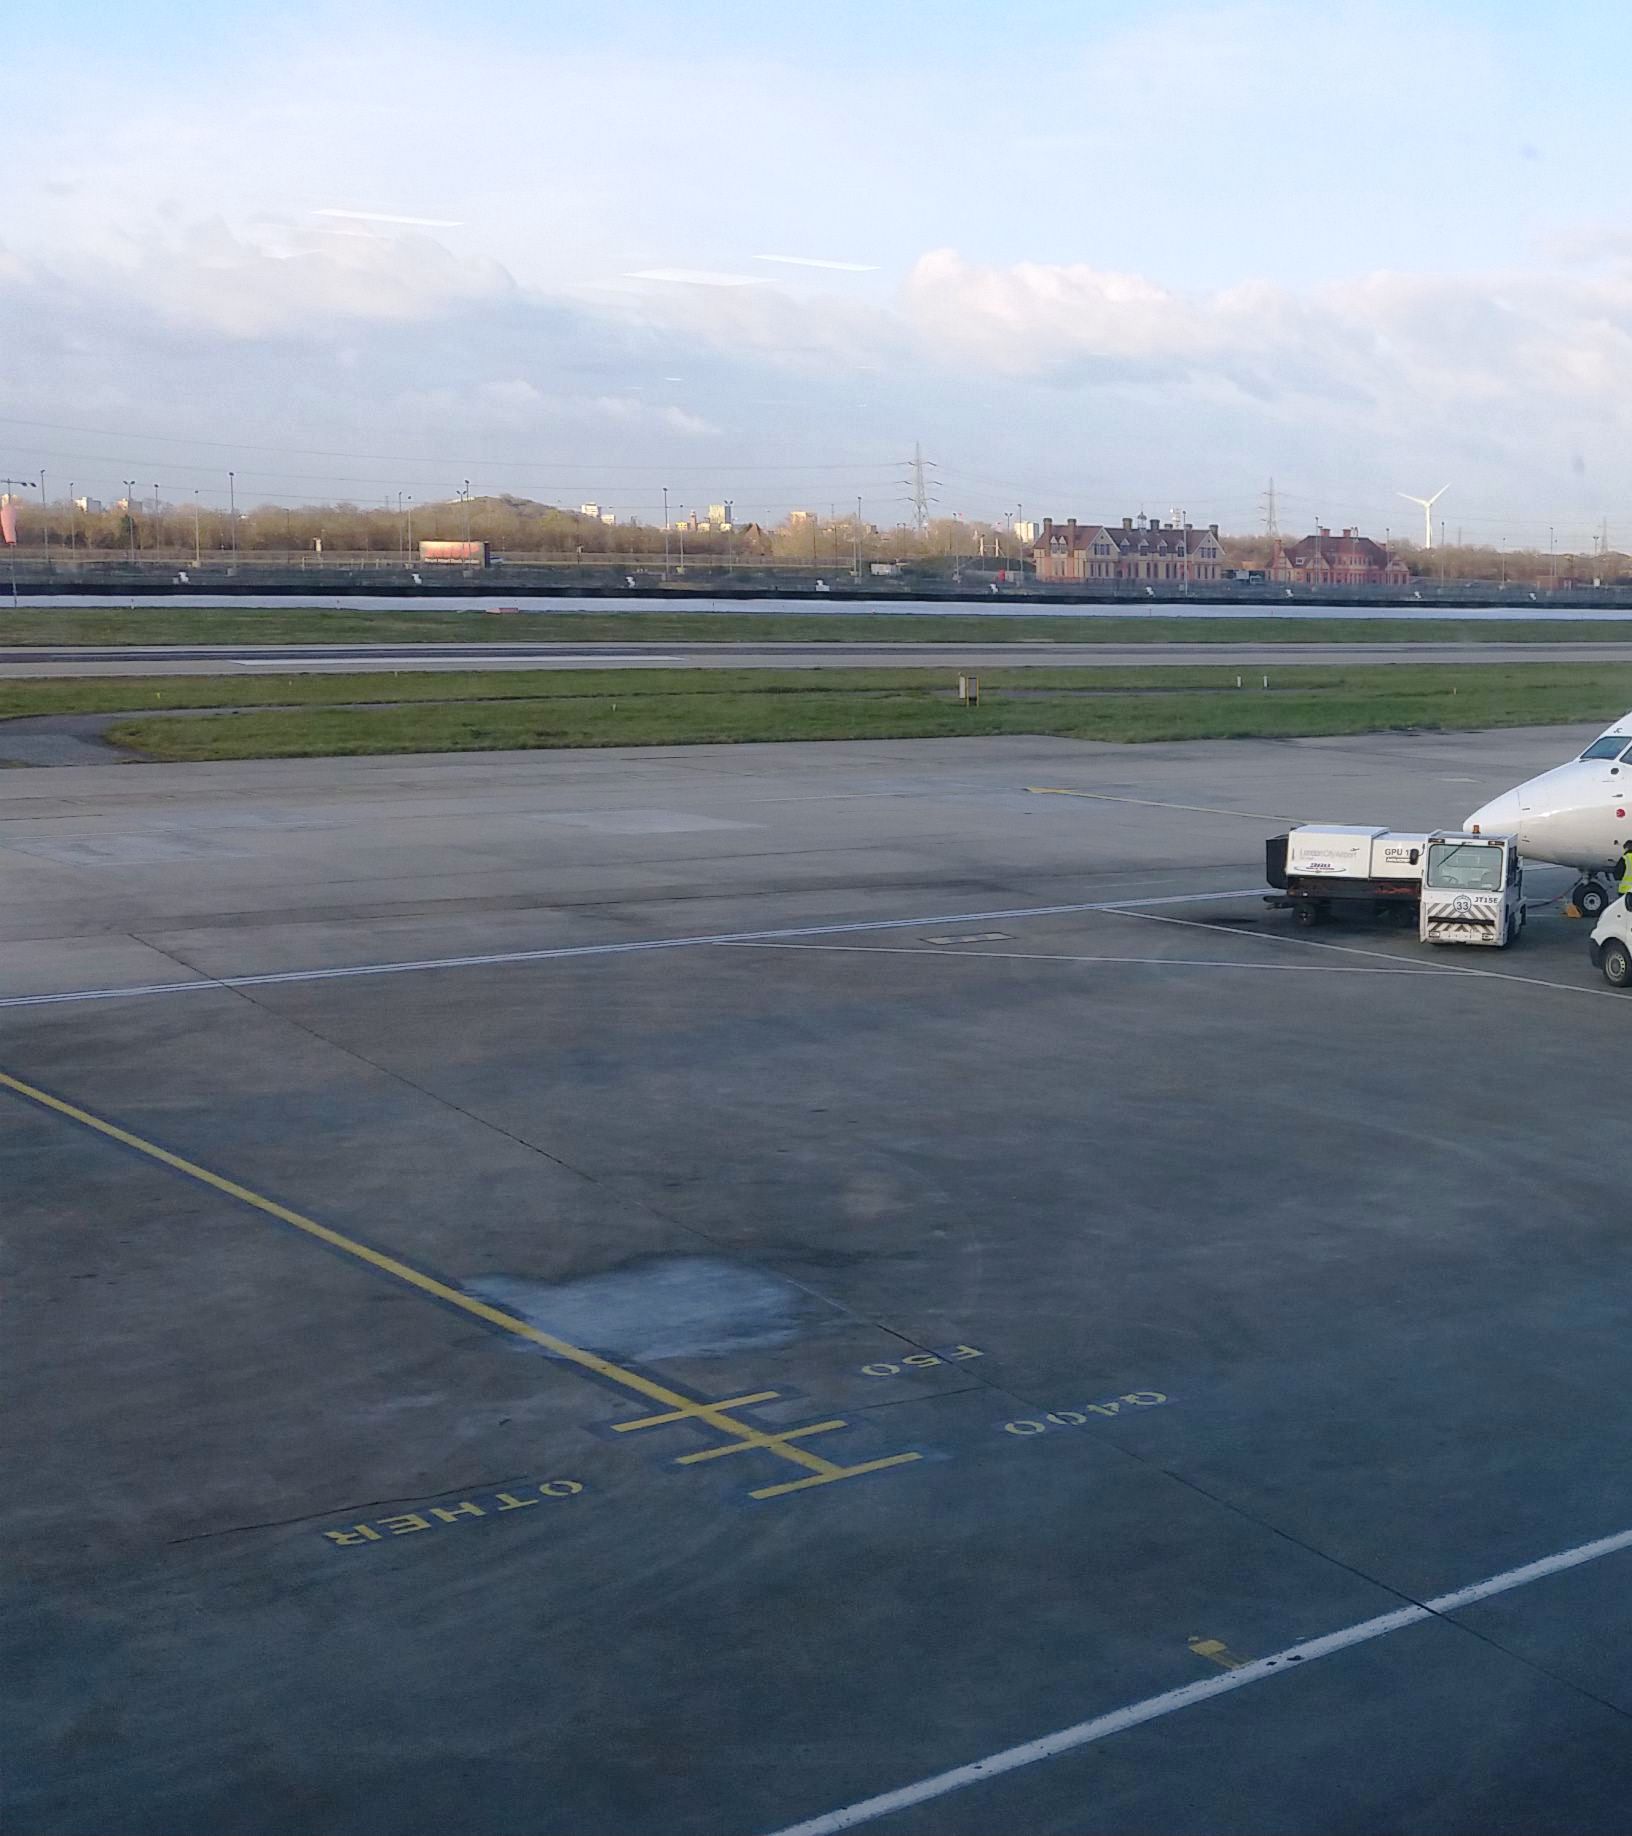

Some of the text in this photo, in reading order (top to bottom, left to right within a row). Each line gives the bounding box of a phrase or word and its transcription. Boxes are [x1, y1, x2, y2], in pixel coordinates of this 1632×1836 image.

[1384, 848, 1403, 856] GPU
[1456, 901, 1469, 911] 33
[860, 1344, 985, 1377] F50
[1004, 1390, 1168, 1436] Q400
[323, 1479, 583, 1547] OTHER
